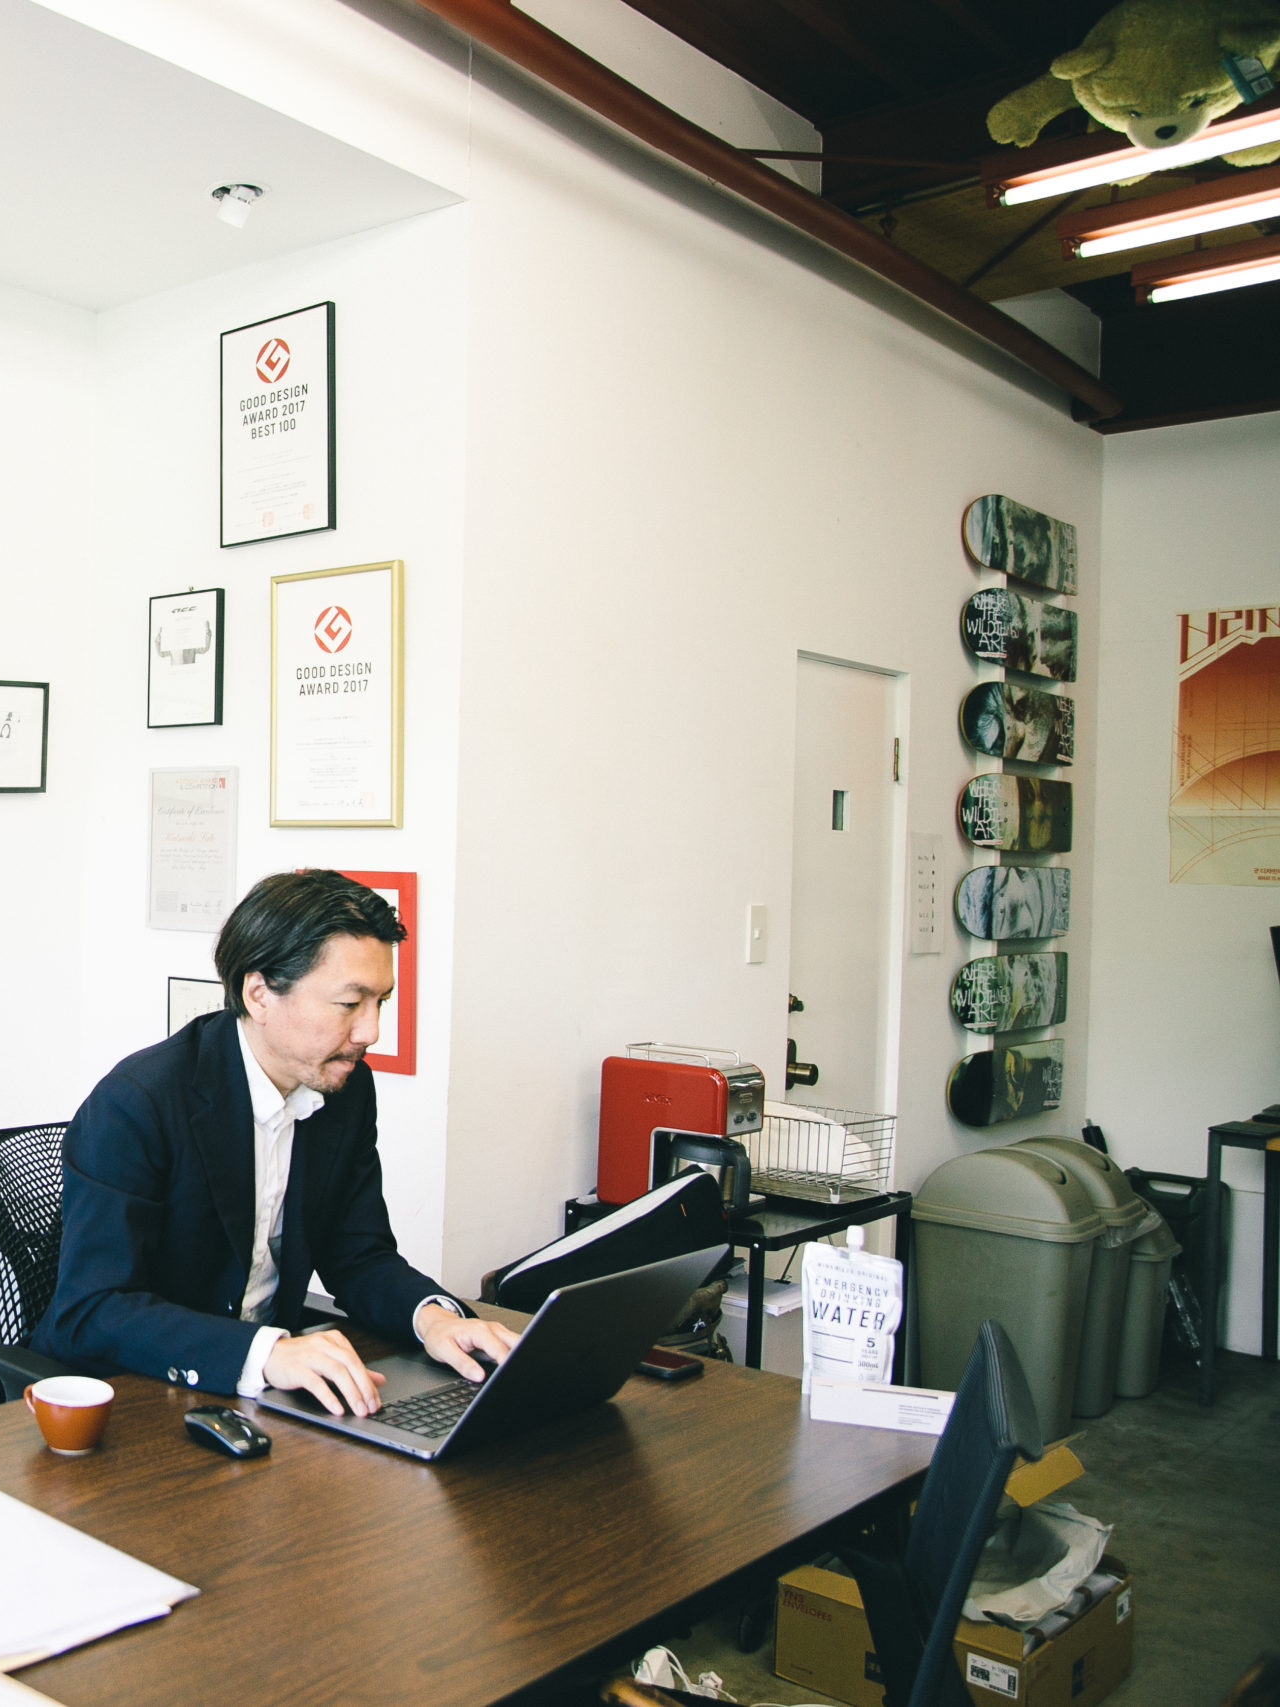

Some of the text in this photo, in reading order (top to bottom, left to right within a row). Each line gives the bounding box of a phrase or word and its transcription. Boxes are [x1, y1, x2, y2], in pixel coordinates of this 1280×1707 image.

[239, 383, 309, 412] GOOD DESIGN
[242, 400, 306, 427] AWARD 2017
[251, 418, 296, 440] BEST 100
[296, 661, 372, 680] GOOD DESIGN
[299, 678, 369, 696] AWARD 2017
[815, 1275, 888, 1297] EMERGENCY
[821, 1288, 881, 1308] DRINKING
[812, 1299, 885, 1330] WATER
[866, 1337, 875, 1348] 5
